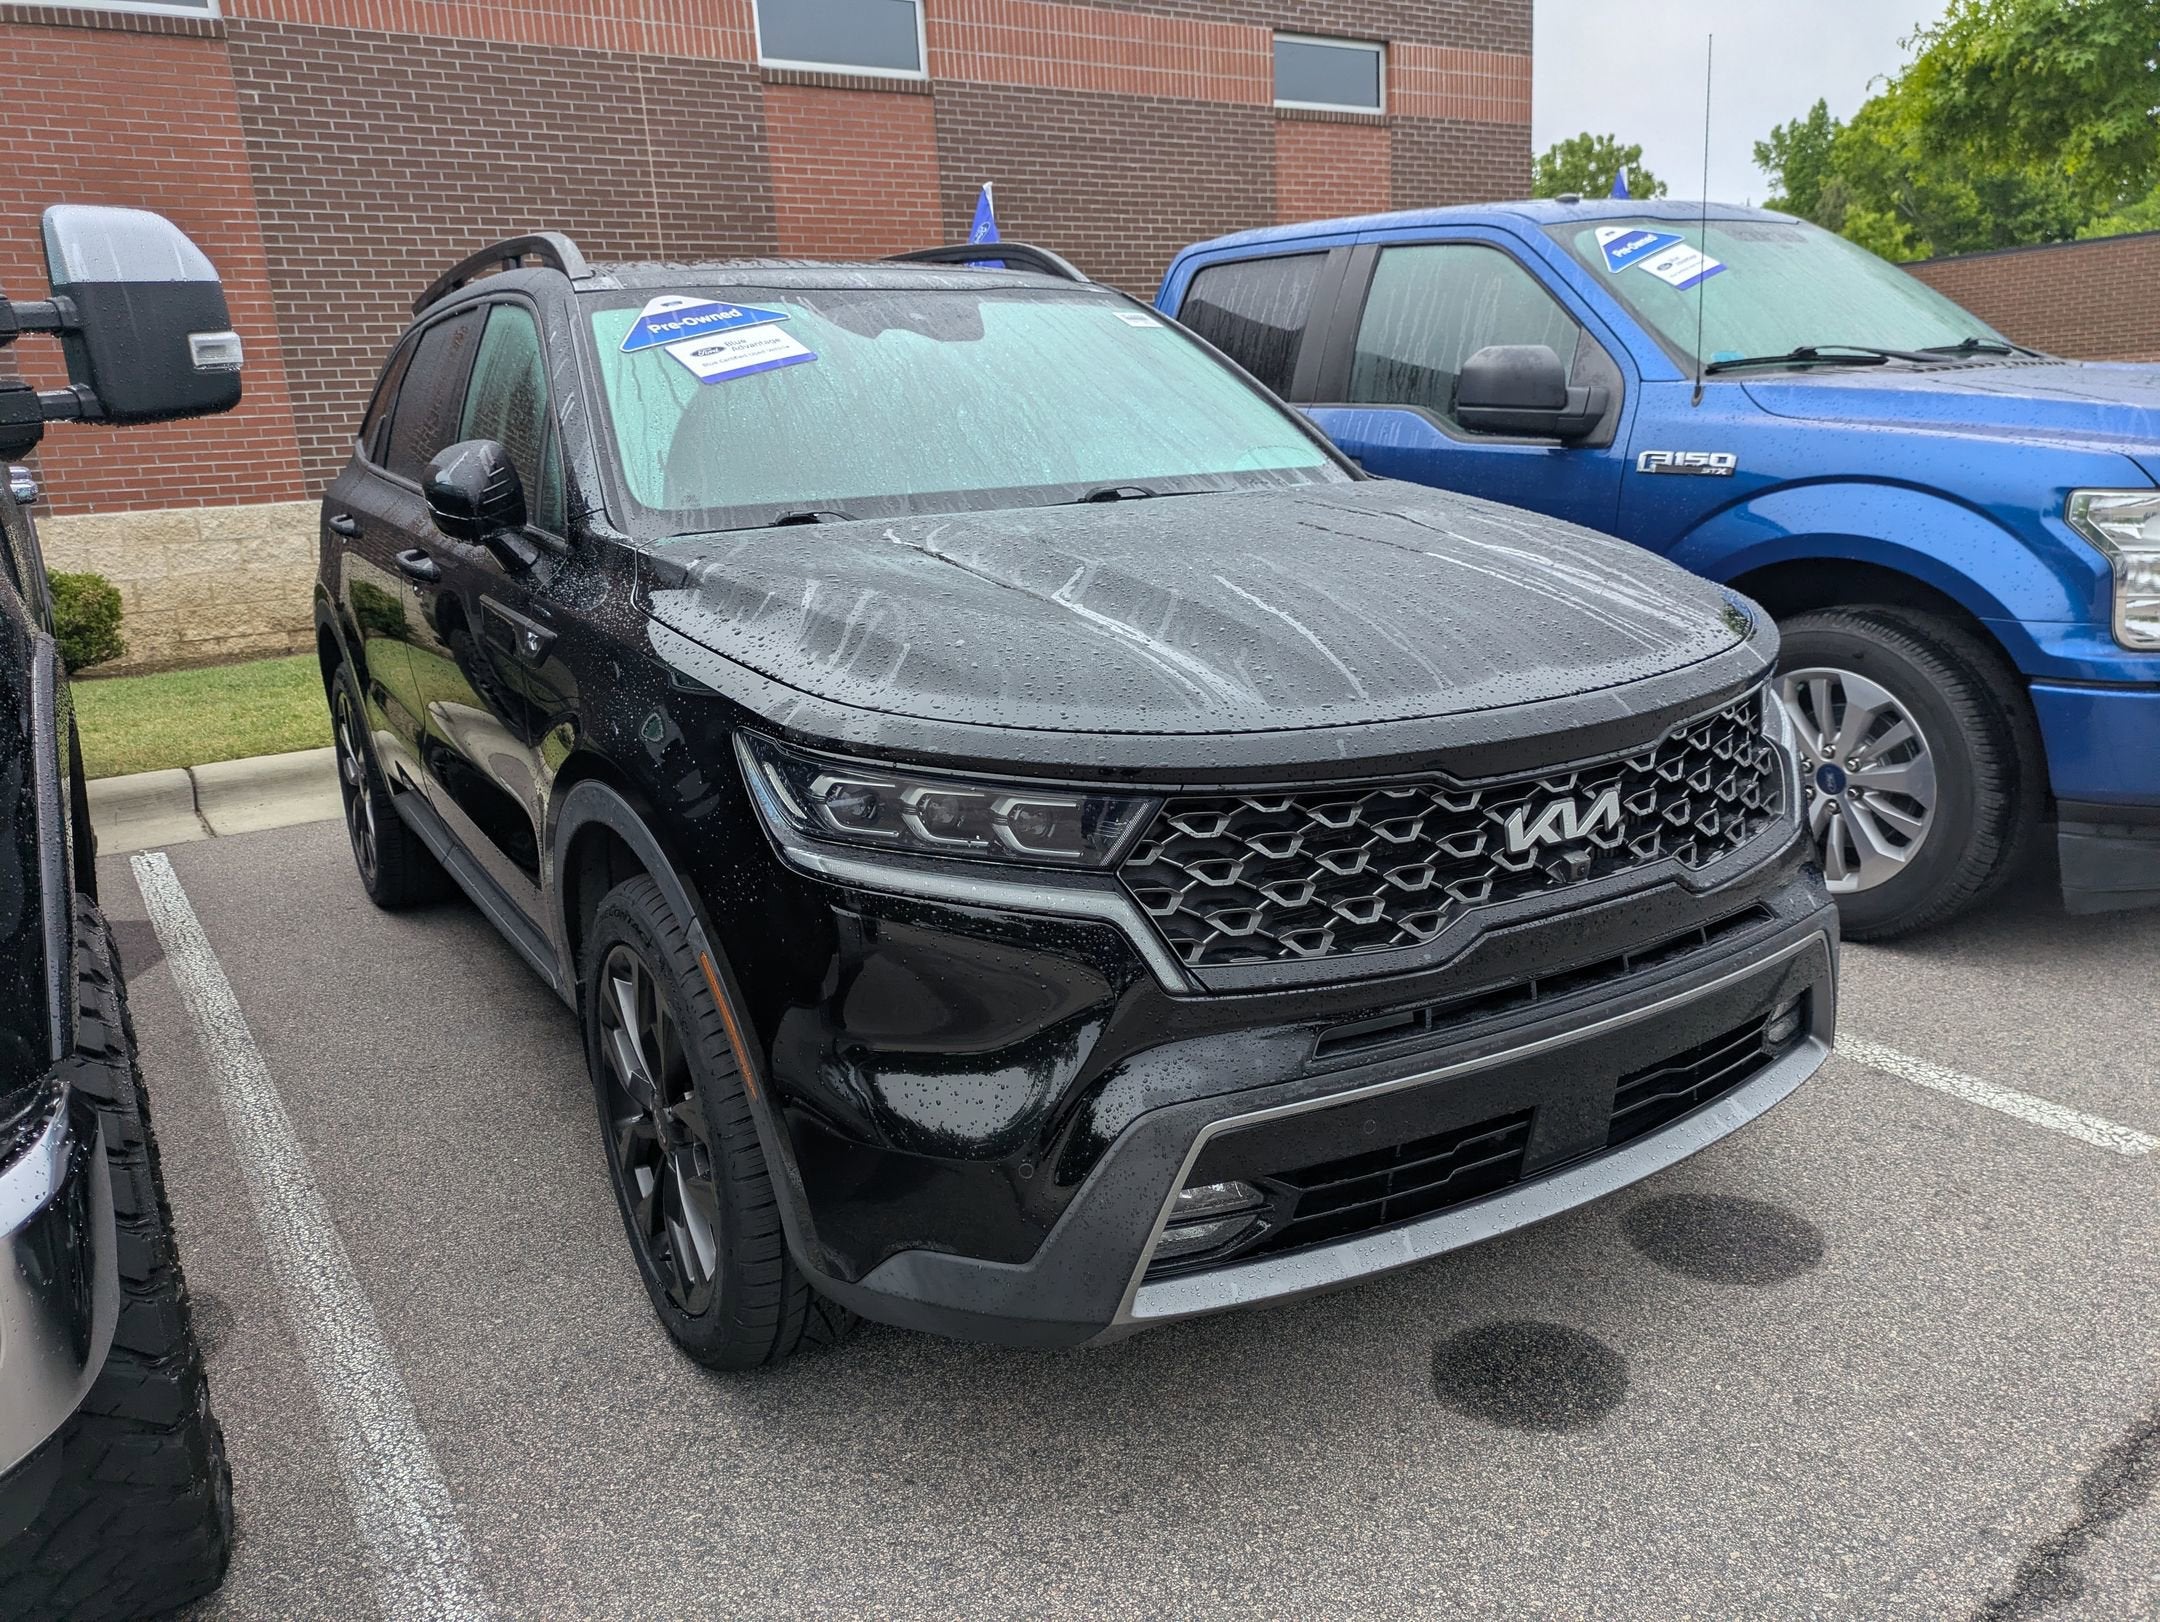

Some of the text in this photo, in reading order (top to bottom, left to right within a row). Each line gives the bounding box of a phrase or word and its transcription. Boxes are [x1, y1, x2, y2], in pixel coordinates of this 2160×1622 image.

[648, 308, 743, 334] Pre-Owned
[724, 338, 747, 347] Blue
[731, 338, 781, 351] Advantage
[1701, 467, 1727, 475] STX
[1504, 787, 1620, 854] KIA
